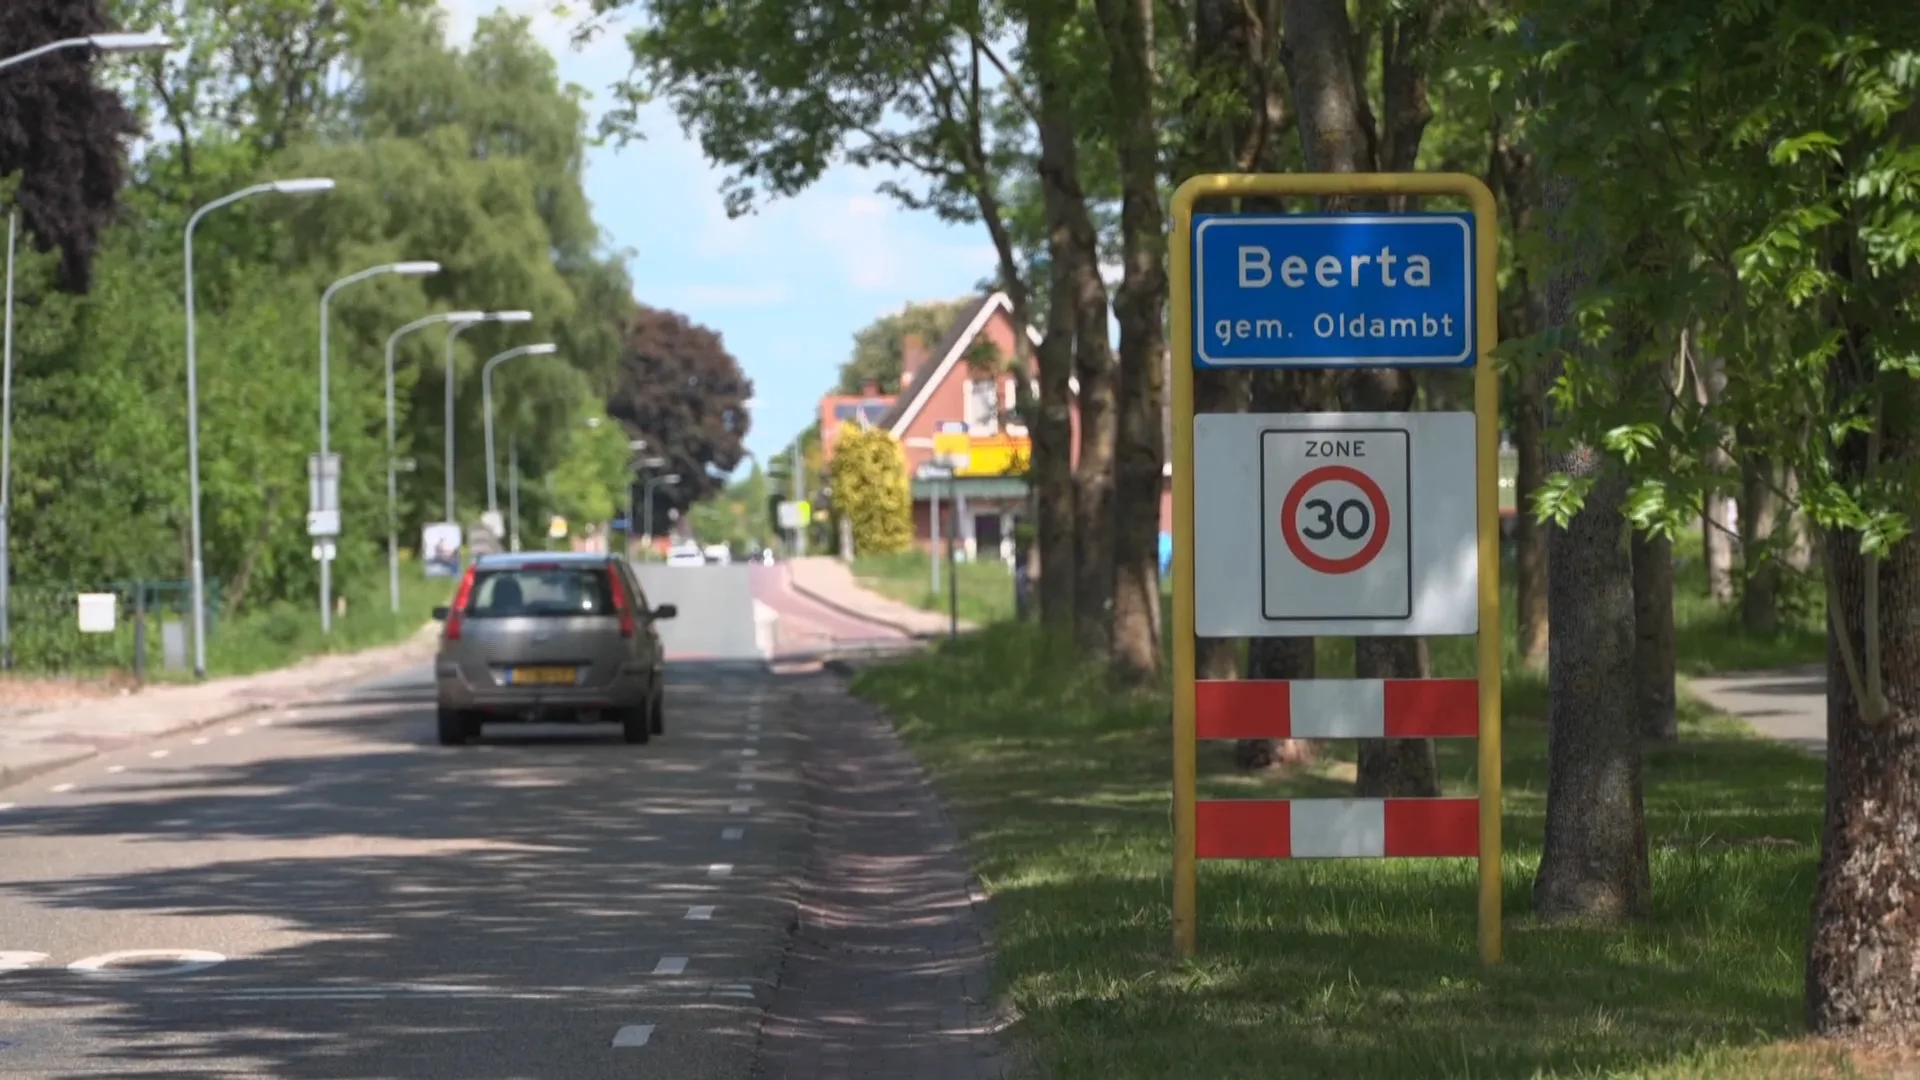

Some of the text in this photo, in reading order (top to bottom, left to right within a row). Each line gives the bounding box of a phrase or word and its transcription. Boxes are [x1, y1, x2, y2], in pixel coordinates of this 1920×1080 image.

[1238, 246, 1431, 288] Beerta
[1215, 312, 1453, 346] gem. Oldambt
[1305, 441, 1366, 457] ZONE
[1302, 499, 1370, 540] 30
